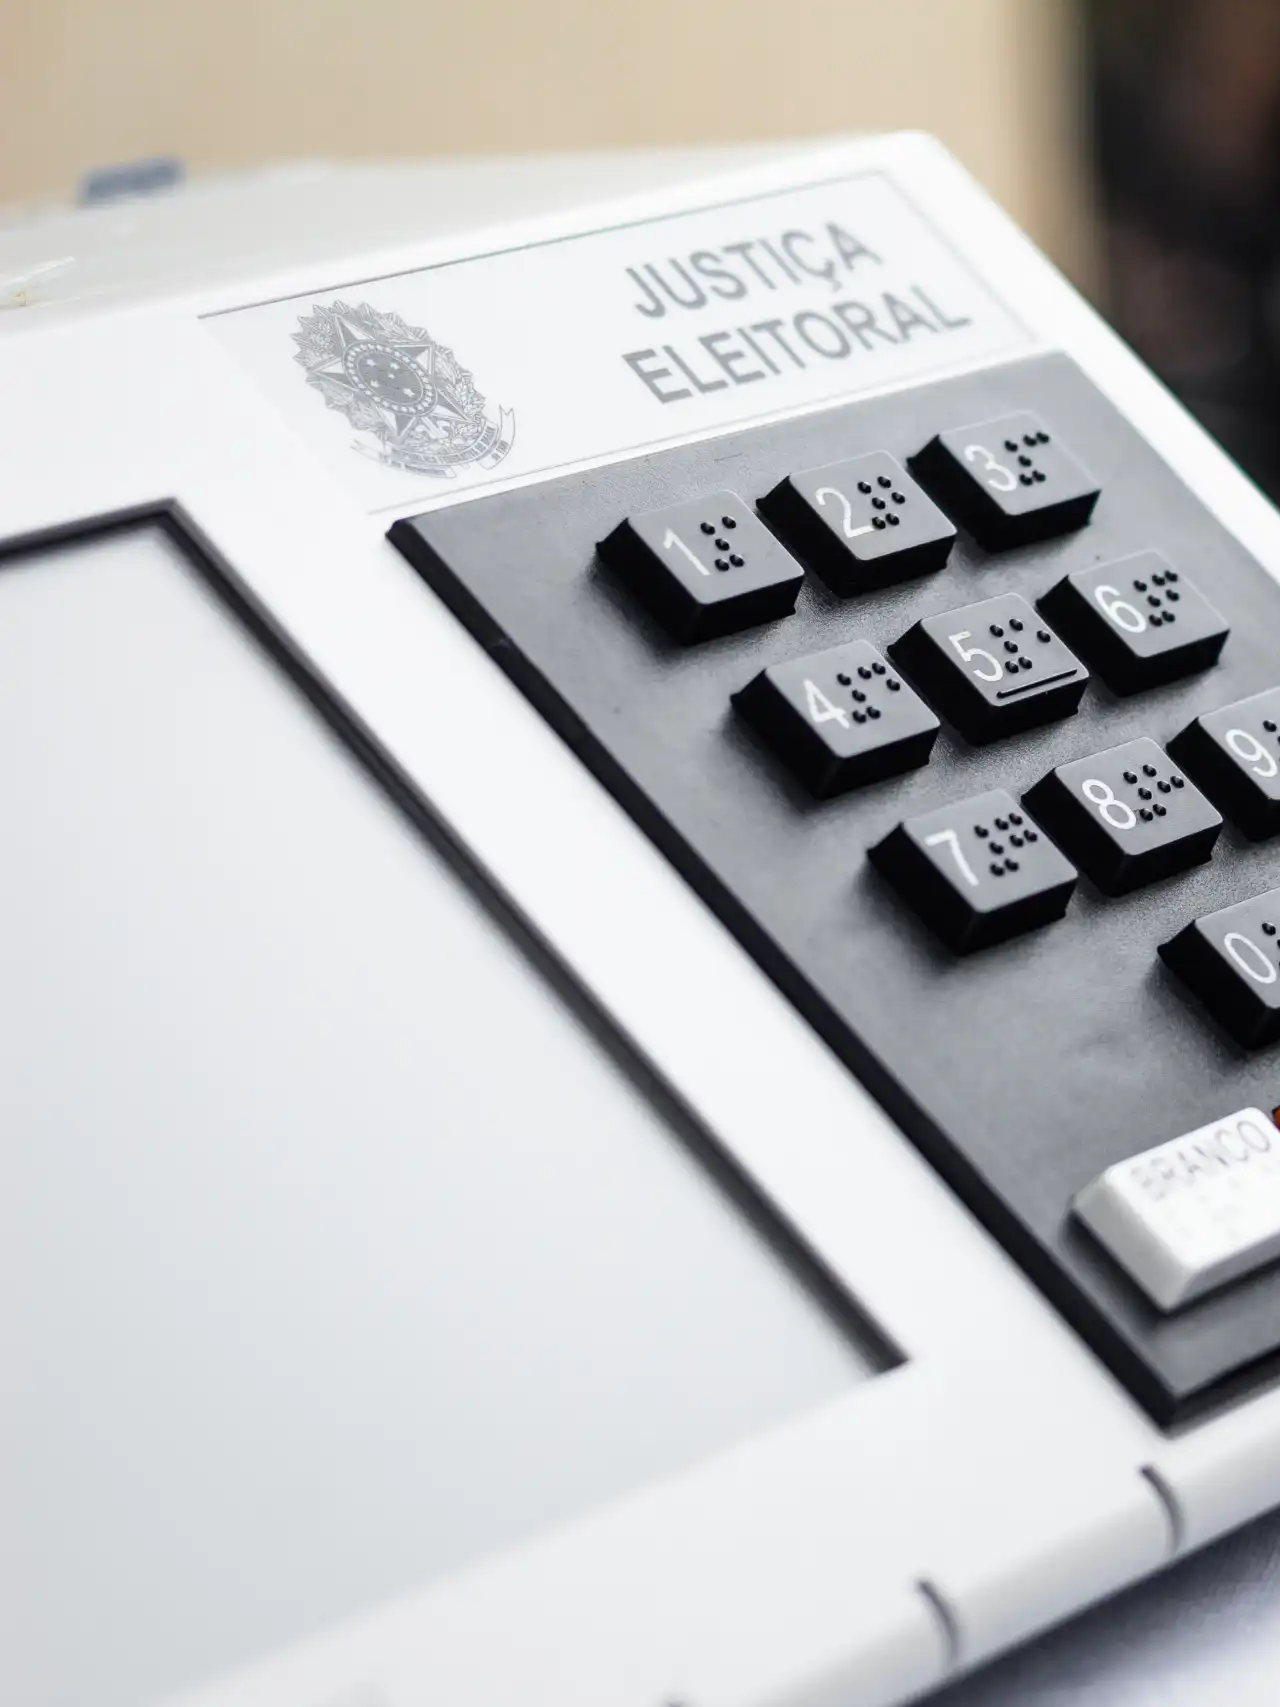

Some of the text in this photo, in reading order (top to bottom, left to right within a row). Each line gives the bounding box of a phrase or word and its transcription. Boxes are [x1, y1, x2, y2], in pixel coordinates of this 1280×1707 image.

[624, 221, 884, 319] JUSTIÇA
[621, 284, 973, 404] ELEITORAL
[963, 444, 1018, 491] 3
[815, 486, 876, 538] 2
[663, 528, 710, 576] 1
[1093, 585, 1148, 633] 6
[948, 630, 1003, 682] 5
[803, 679, 851, 729] 4
[1224, 728, 1278, 778] 9
[1081, 778, 1137, 830] 8
[924, 829, 980, 887] 7
[1223, 932, 1278, 985] 0
